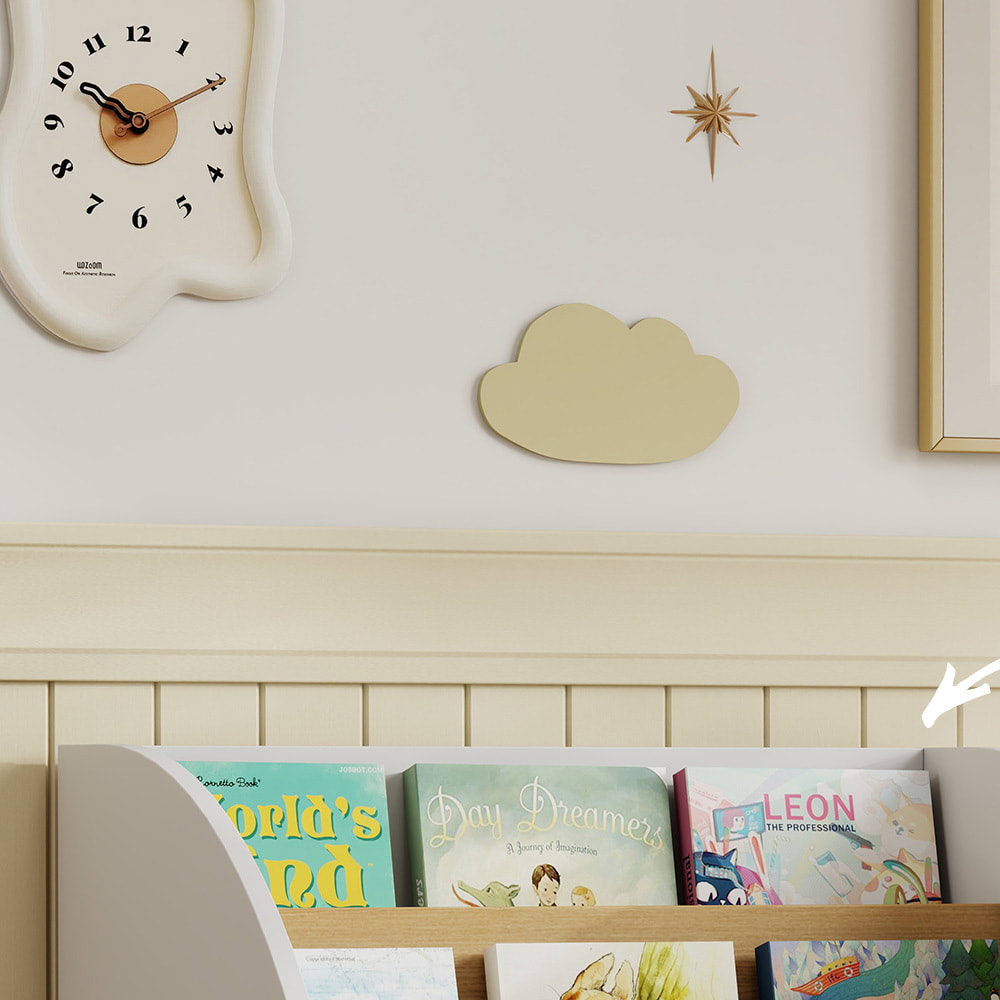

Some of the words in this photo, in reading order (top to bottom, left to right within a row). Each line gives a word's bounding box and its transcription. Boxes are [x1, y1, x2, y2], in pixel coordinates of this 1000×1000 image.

[82, 33, 107, 56] 11
[126, 25, 152, 43] 12
[175, 38, 190, 57] 1
[49, 60, 75, 92] 10
[43, 113, 65, 131] 9
[212, 120, 234, 136] 3
[51, 158, 74, 179] 8
[206, 163, 225, 183] 4
[85, 193, 105, 215] 7
[175, 195, 193, 219] 5
[131, 206, 148, 229] 6
[427, 785, 503, 849] Day
[516, 775, 664, 851] Dreamers
[763, 793, 855, 821] LEON
[766, 823, 785, 832] THE
[786, 824, 856, 832] PROFESSIONAL
[516, 841, 544, 855] Journey
[546, 841, 553, 850] of
[556, 840, 598, 856] Imagination
[246, 844, 369, 908] nd
